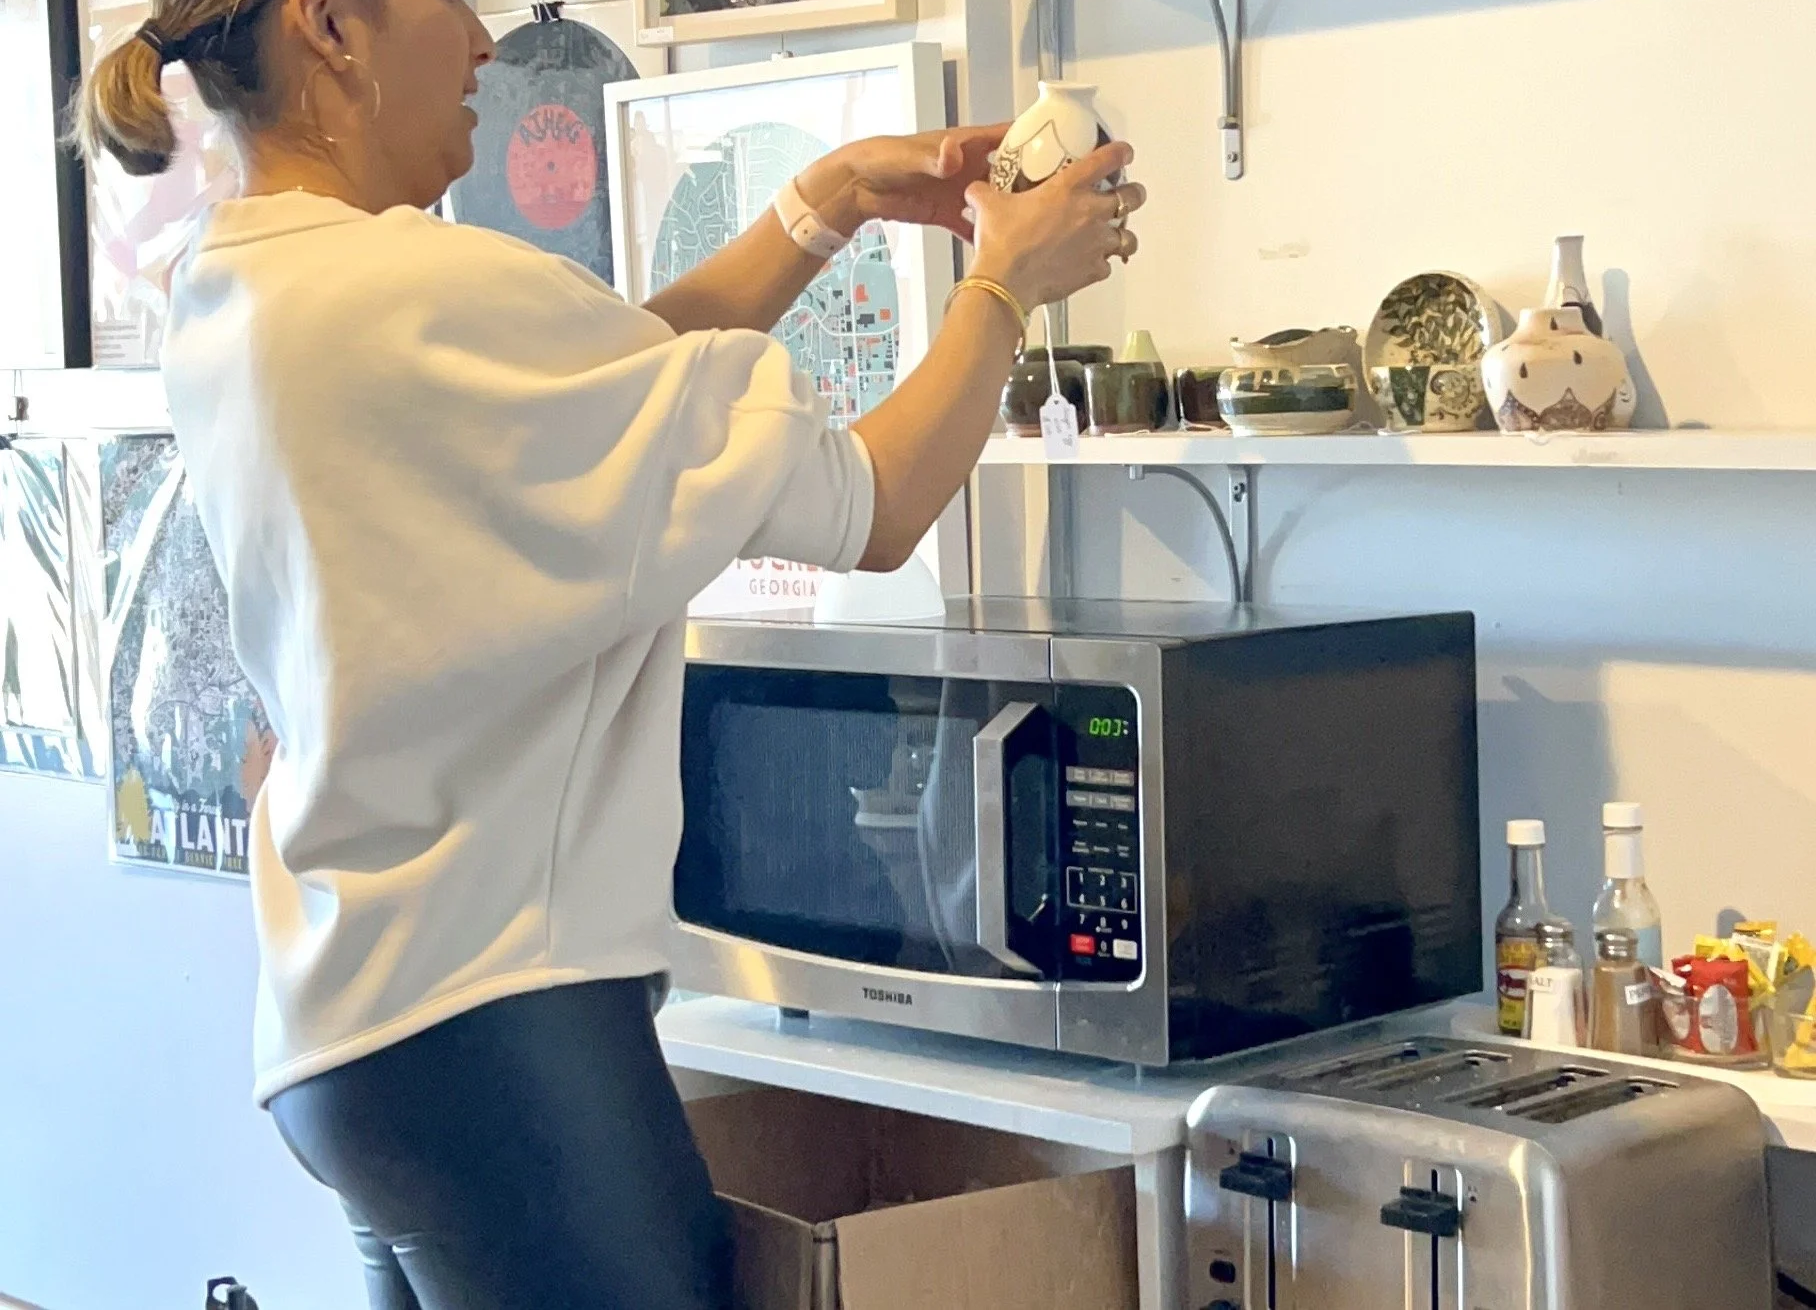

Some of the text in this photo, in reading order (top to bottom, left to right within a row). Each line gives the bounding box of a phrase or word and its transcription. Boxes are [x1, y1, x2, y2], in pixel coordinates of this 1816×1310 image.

[749, 578, 817, 598] GEORGIA
[150, 808, 247, 857] ALANT
[862, 987, 913, 1006] TOSHIBA
